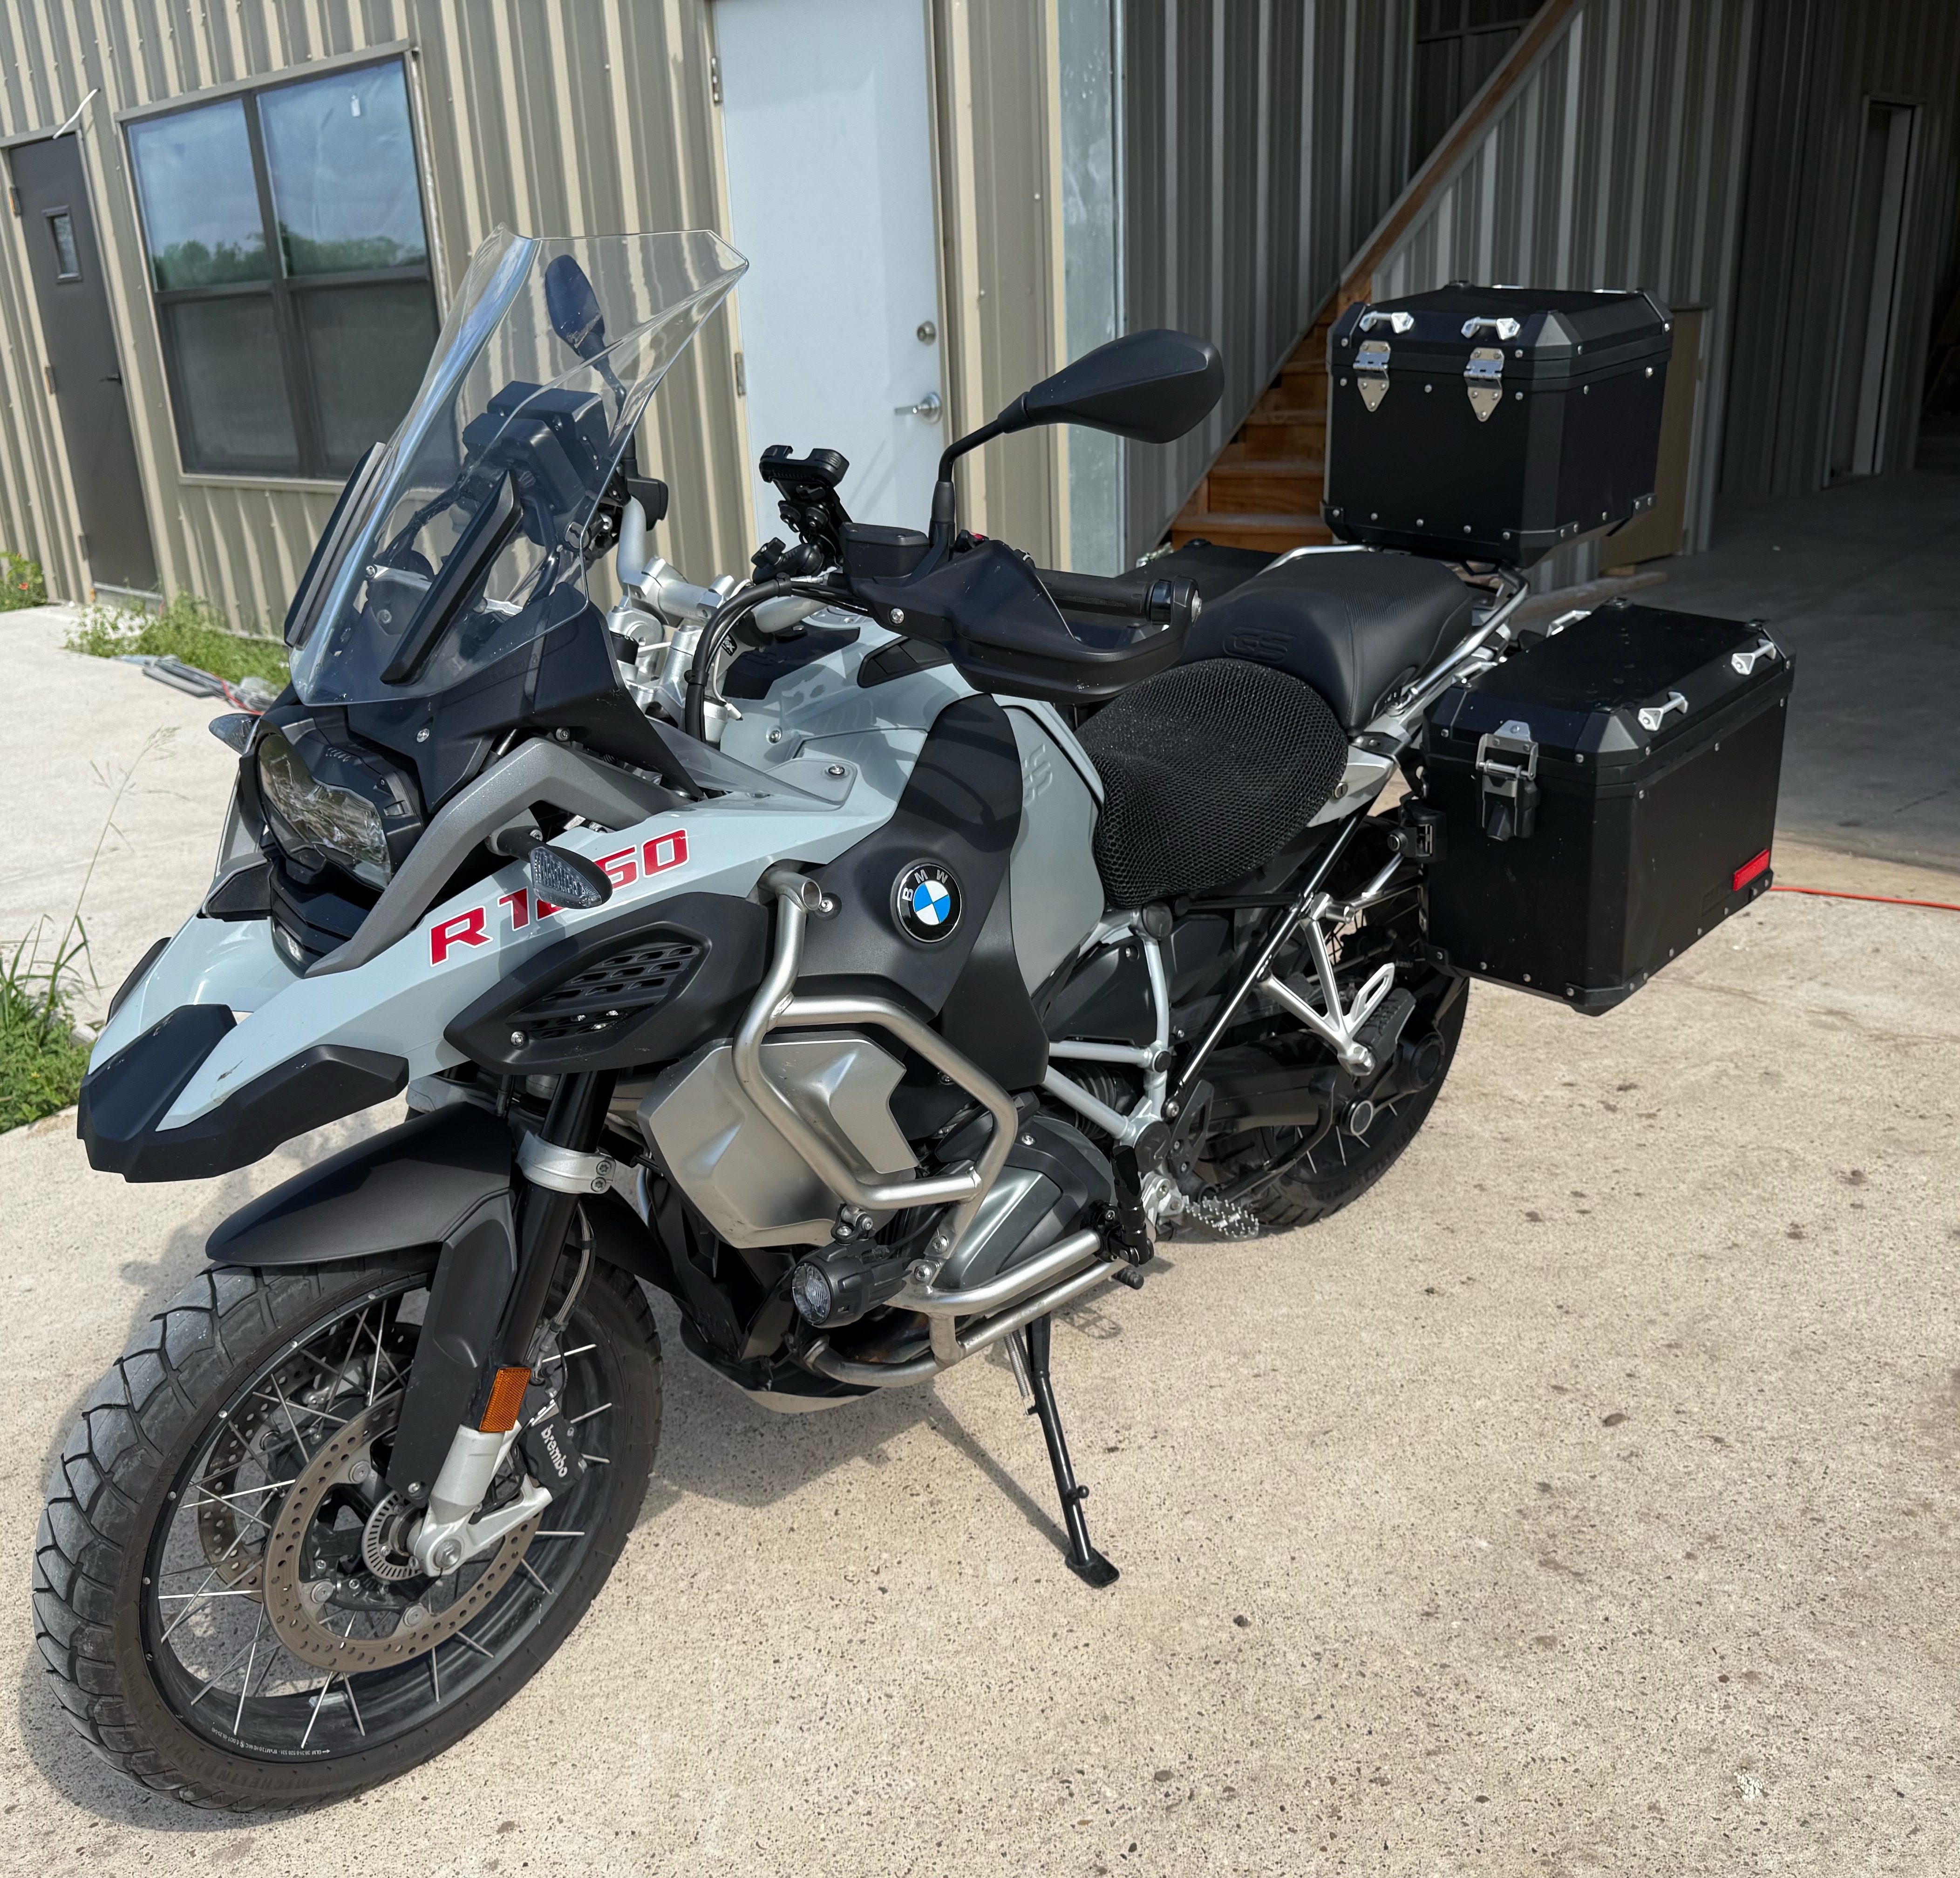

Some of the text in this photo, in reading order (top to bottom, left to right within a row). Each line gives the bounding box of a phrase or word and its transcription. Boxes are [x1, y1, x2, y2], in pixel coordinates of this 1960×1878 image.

[429, 828, 690, 967] R 150
[902, 869, 948, 901] BMW
[540, 1423, 568, 1477] brembo
[216, 1769, 311, 1790] MICHELIN
